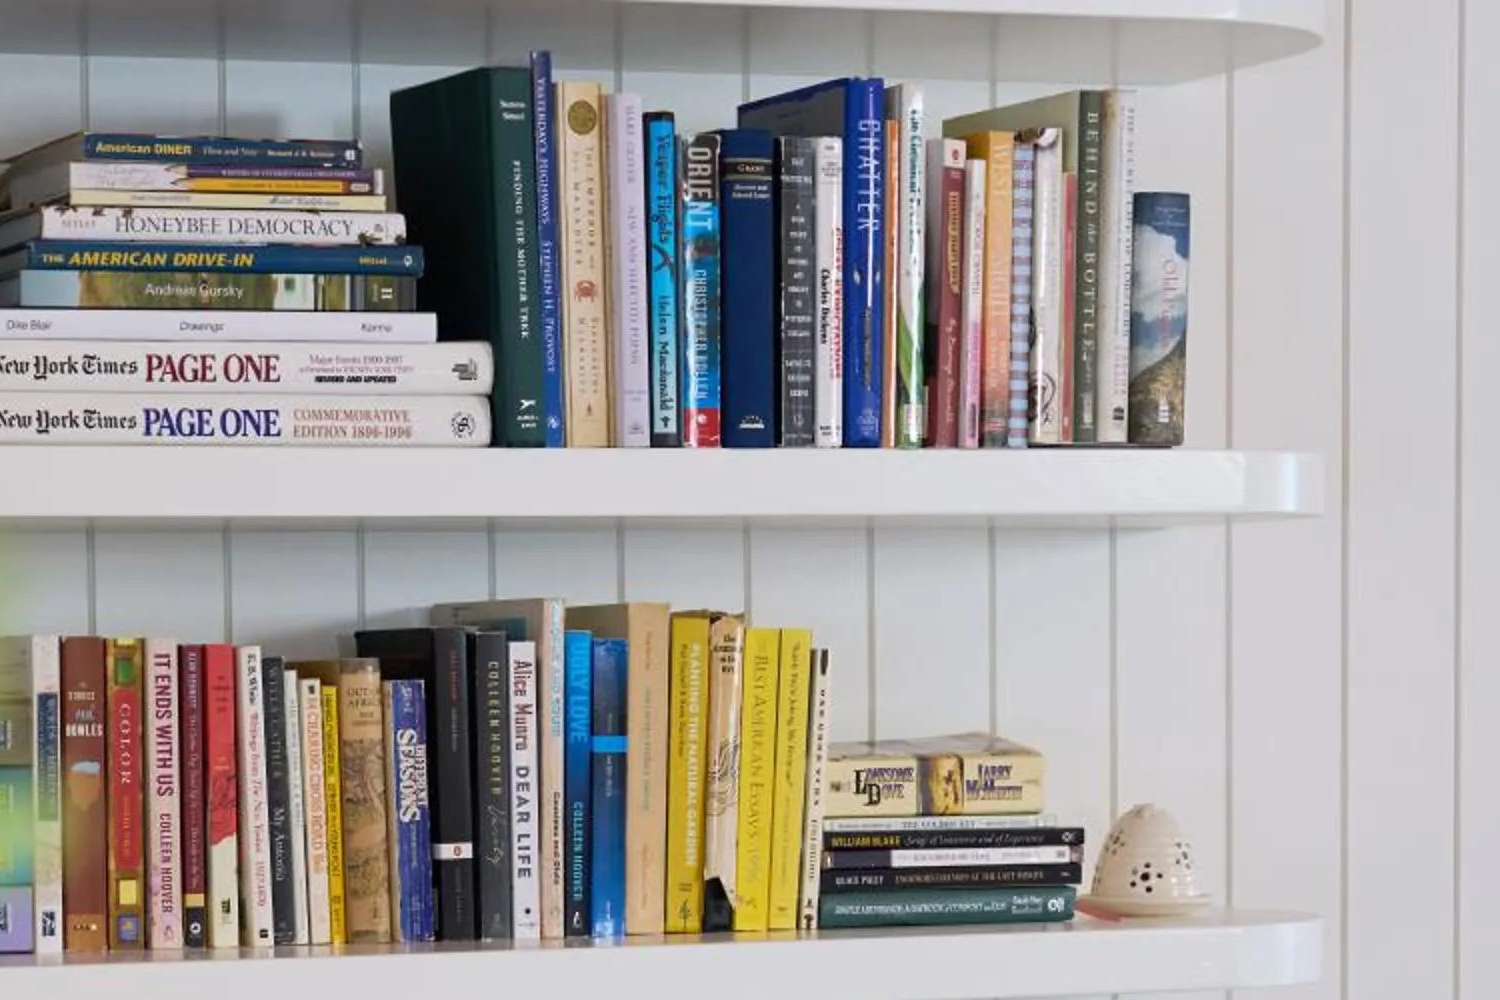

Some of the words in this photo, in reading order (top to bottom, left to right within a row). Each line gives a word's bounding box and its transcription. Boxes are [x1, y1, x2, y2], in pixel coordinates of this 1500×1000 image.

[95, 142, 151, 155] American
[154, 144, 192, 156] DINER
[1085, 112, 1099, 214] BEHIND
[512, 159, 524, 215] FINDING
[538, 158, 551, 224] HIGHWAYS
[687, 147, 712, 231] ORIENT
[857, 120, 881, 231] CHATTER
[114, 215, 221, 235] HONEYBEE
[228, 216, 354, 237] DEMOCRACY
[515, 220, 525, 246] THE
[650, 195, 673, 243] Flights
[67, 251, 167, 267] AMERICAN
[172, 252, 254, 267] DRIVE-IN
[516, 248, 528, 301] MOTHER
[540, 241, 553, 295] STEPHEN
[144, 283, 196, 297] Andreas
[198, 285, 245, 300] Gursky
[820, 269, 831, 305] Charles
[1083, 253, 1097, 352] BOTTLE
[5, 319, 29, 331] Dike
[29, 319, 52, 331] Blair
[658, 295, 671, 335] Helen
[820, 307, 831, 345] Dickens
[33, 353, 80, 381] York
[81, 353, 139, 375] Times
[144, 353, 217, 383] PAGE
[223, 354, 281, 383] ONE
[545, 317, 556, 373] PROVOST
[658, 341, 675, 411] Macdonald
[34, 409, 80, 434] York
[82, 408, 137, 429] Times
[142, 407, 215, 437] PAGE
[220, 408, 282, 437] ONE
[293, 409, 412, 423] COMMEMORATIVE
[293, 425, 349, 438] EDITION
[154, 653, 170, 670] IT
[513, 659, 533, 697] Alice
[569, 641, 590, 692] UGLY
[688, 643, 700, 713] PLANTING
[754, 655, 769, 690] BEST
[154, 675, 172, 719] ENDS
[487, 661, 501, 727] COLLEEN
[513, 703, 534, 751] Munro
[570, 695, 590, 743] LOVE
[687, 715, 699, 741] THE
[750, 695, 768, 777] AMERICAN
[118, 704, 132, 785] COLOR
[156, 724, 173, 770] WITH
[490, 733, 503, 796] HOOVER
[157, 775, 174, 798] US
[395, 728, 421, 823] SEASONS
[416, 743, 428, 807] DIFFERENT
[514, 765, 532, 824] DEAR
[685, 744, 699, 807] NATURAL
[862, 783, 905, 807] DOVE
[269, 806, 284, 828] My
[572, 801, 585, 853] COLLEEN
[748, 782, 765, 840] ESSAYS
[159, 812, 172, 863] COLLEEN
[517, 833, 533, 880] LIFE
[684, 809, 697, 867] GARDEN
[160, 867, 173, 913] HOOVER
[572, 855, 584, 901] HOOVER
